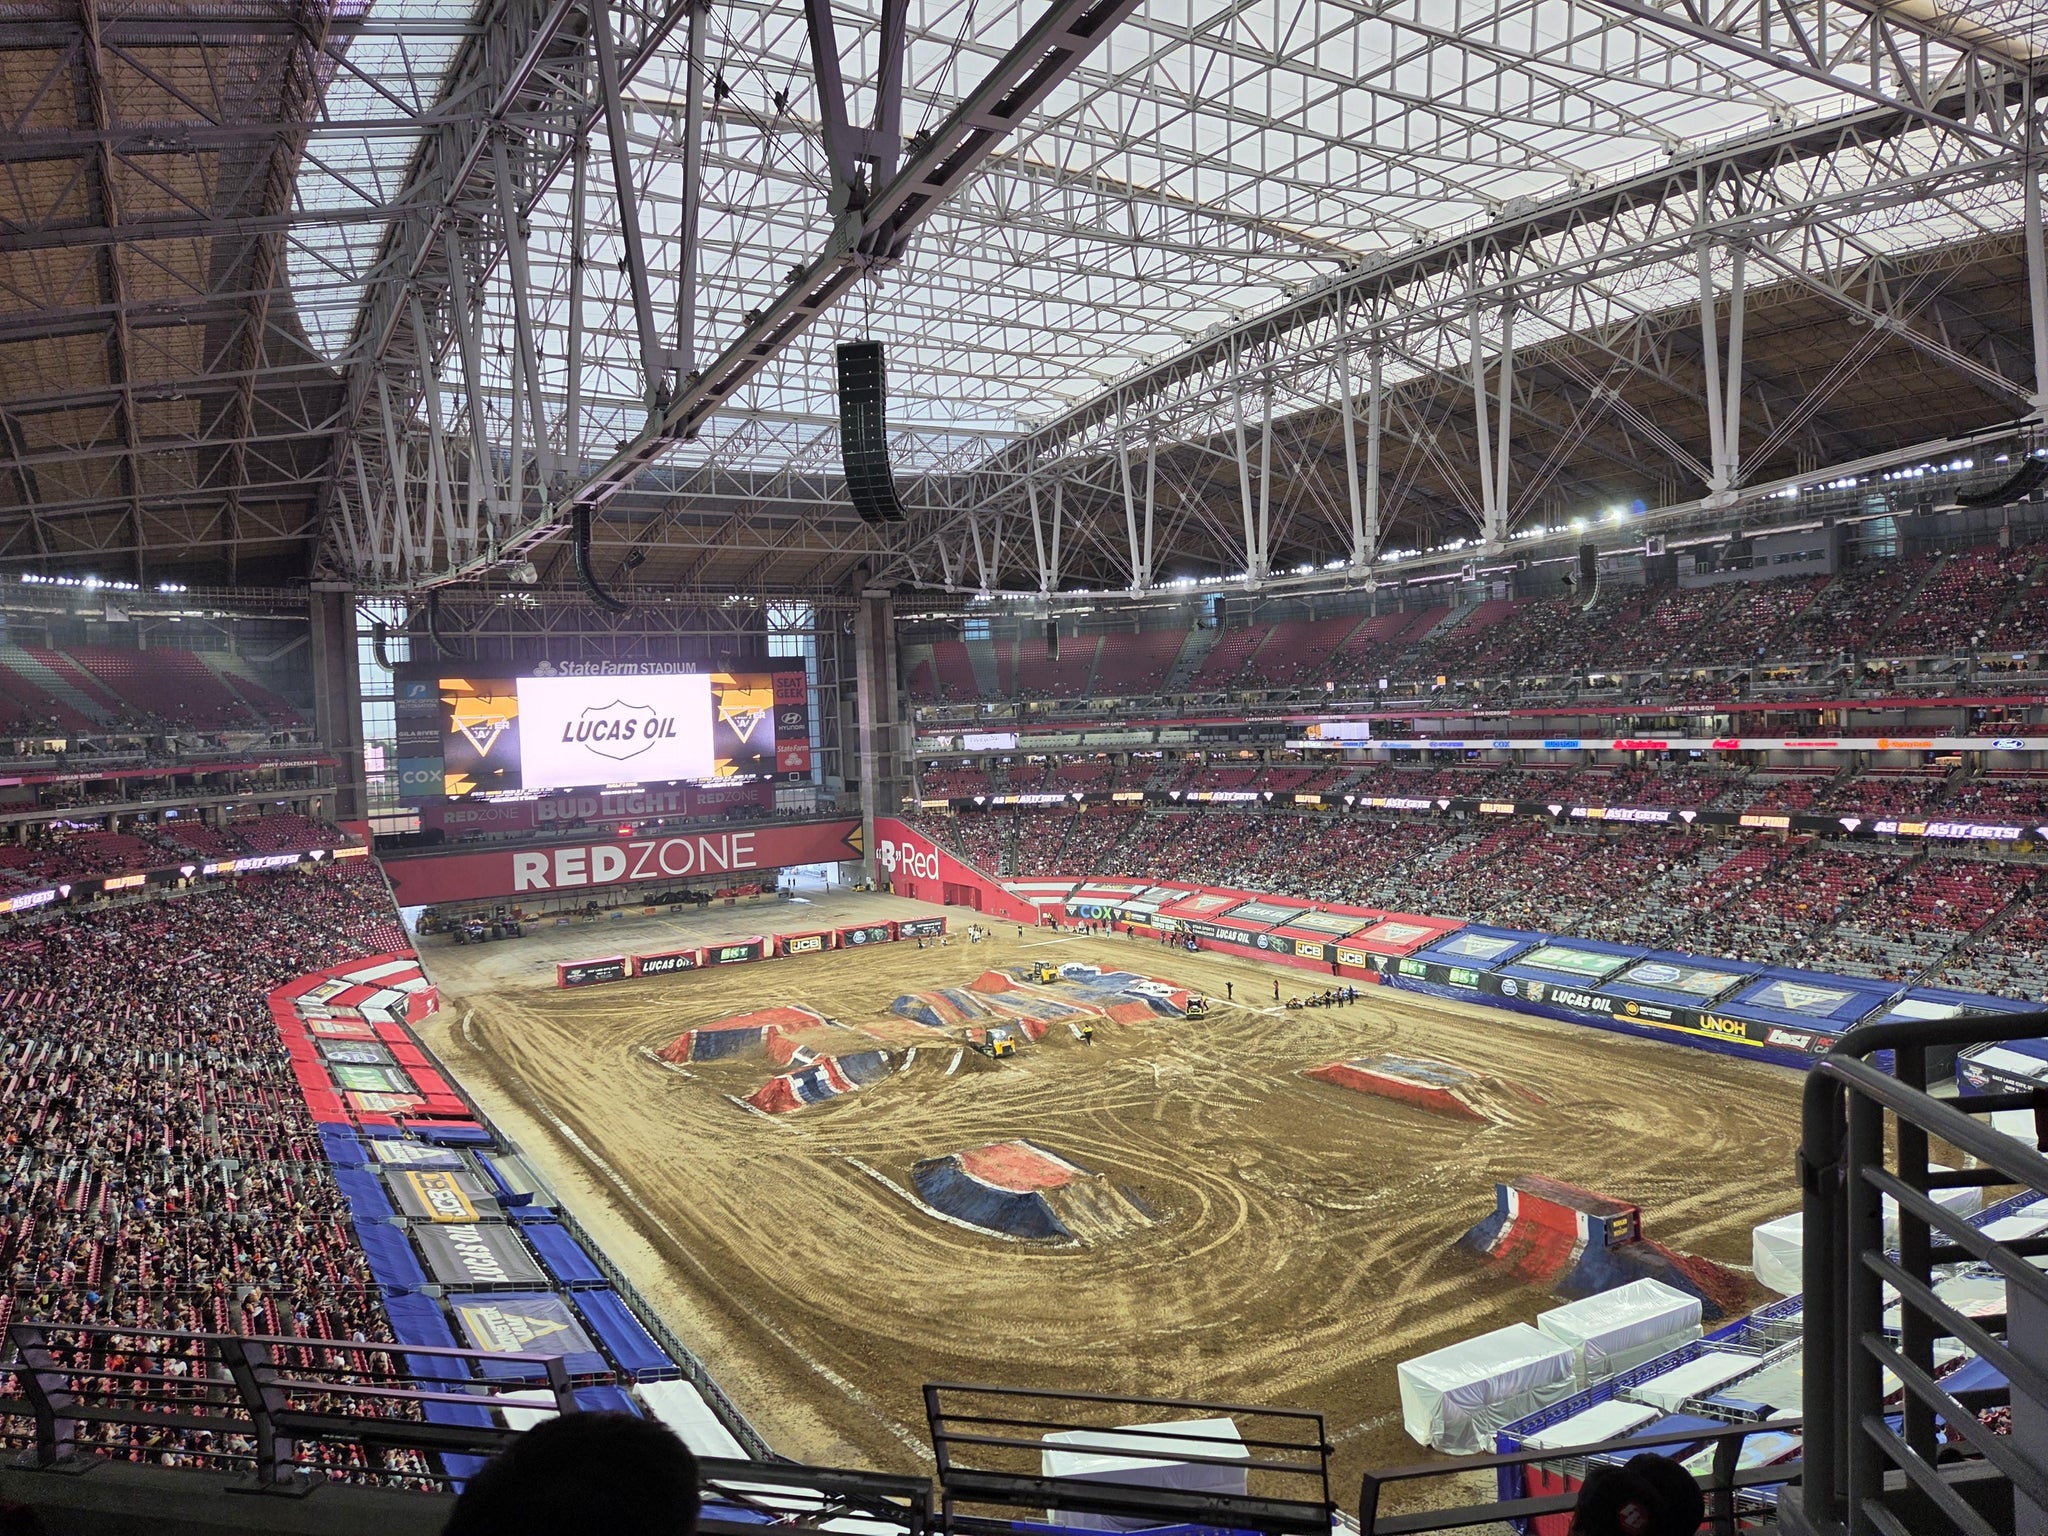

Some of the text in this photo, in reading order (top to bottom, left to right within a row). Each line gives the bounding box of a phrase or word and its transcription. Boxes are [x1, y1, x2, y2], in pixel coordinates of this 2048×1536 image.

[640, 662, 697, 674] STADIUM
[777, 678, 802, 688] SEAT
[777, 688, 804, 698] GEEK
[562, 718, 676, 742] LUCAS OIL
[402, 770, 442, 784] COX
[697, 790, 758, 804] REDZONE
[538, 792, 681, 821] BUD LIGHT
[444, 807, 520, 823] REDZONE
[1740, 816, 1790, 828] HALFTIME
[1874, 822, 1897, 833] AS
[1898, 822, 1927, 834] BIG
[1927, 823, 1949, 836] AS
[514, 832, 757, 892] REDZONE
[1080, 906, 1112, 920] COX
[1216, 928, 1237, 941] LUCAS
[1238, 932, 1250, 944] OIL
[793, 938, 819, 950] JCB
[1297, 944, 1322, 957] JCB
[642, 959, 674, 972] LUCAS
[1339, 952, 1364, 965] JCB
[1400, 960, 1426, 974] BKT
[1450, 970, 1478, 984] BKT
[1551, 990, 1612, 1012] LUCAS OIL
[1700, 1014, 1746, 1036] UNOH
[1814, 1046, 1830, 1054] CA
[427, 1190, 468, 1216] JCB
[444, 1224, 510, 1282] LUCAS OIL
[480, 1306, 524, 1352] MONSTER
[502, 1313, 536, 1342] JAM
